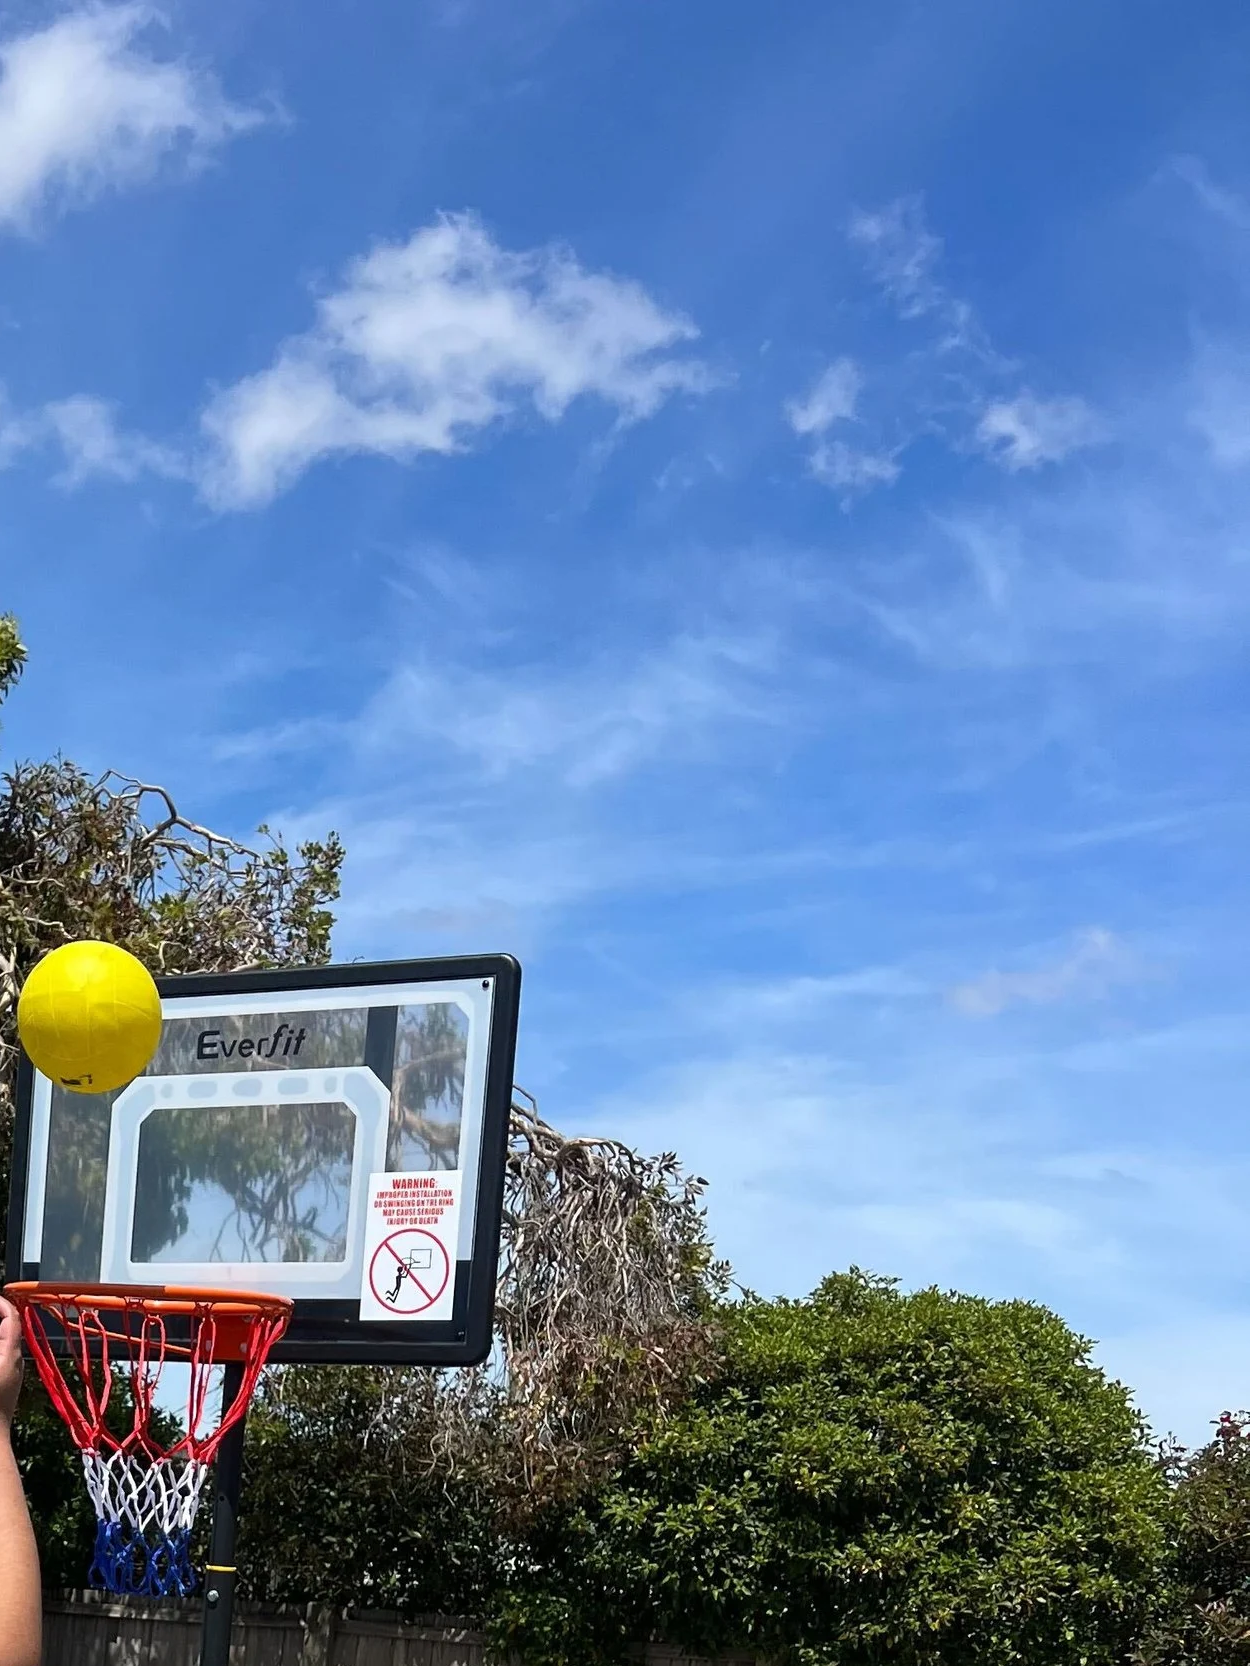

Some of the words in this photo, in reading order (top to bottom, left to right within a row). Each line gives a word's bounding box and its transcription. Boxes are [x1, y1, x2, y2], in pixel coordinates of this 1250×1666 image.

[197, 1023, 306, 1060] Everfit
[392, 1177, 438, 1189] WARNING:
[409, 1189, 452, 1198] INSTALLATION
[438, 1198, 454, 1206] RING
[382, 1209, 395, 1217] MAY
[396, 1208, 416, 1216] CAUSE
[417, 1208, 444, 1216] SERIOUS
